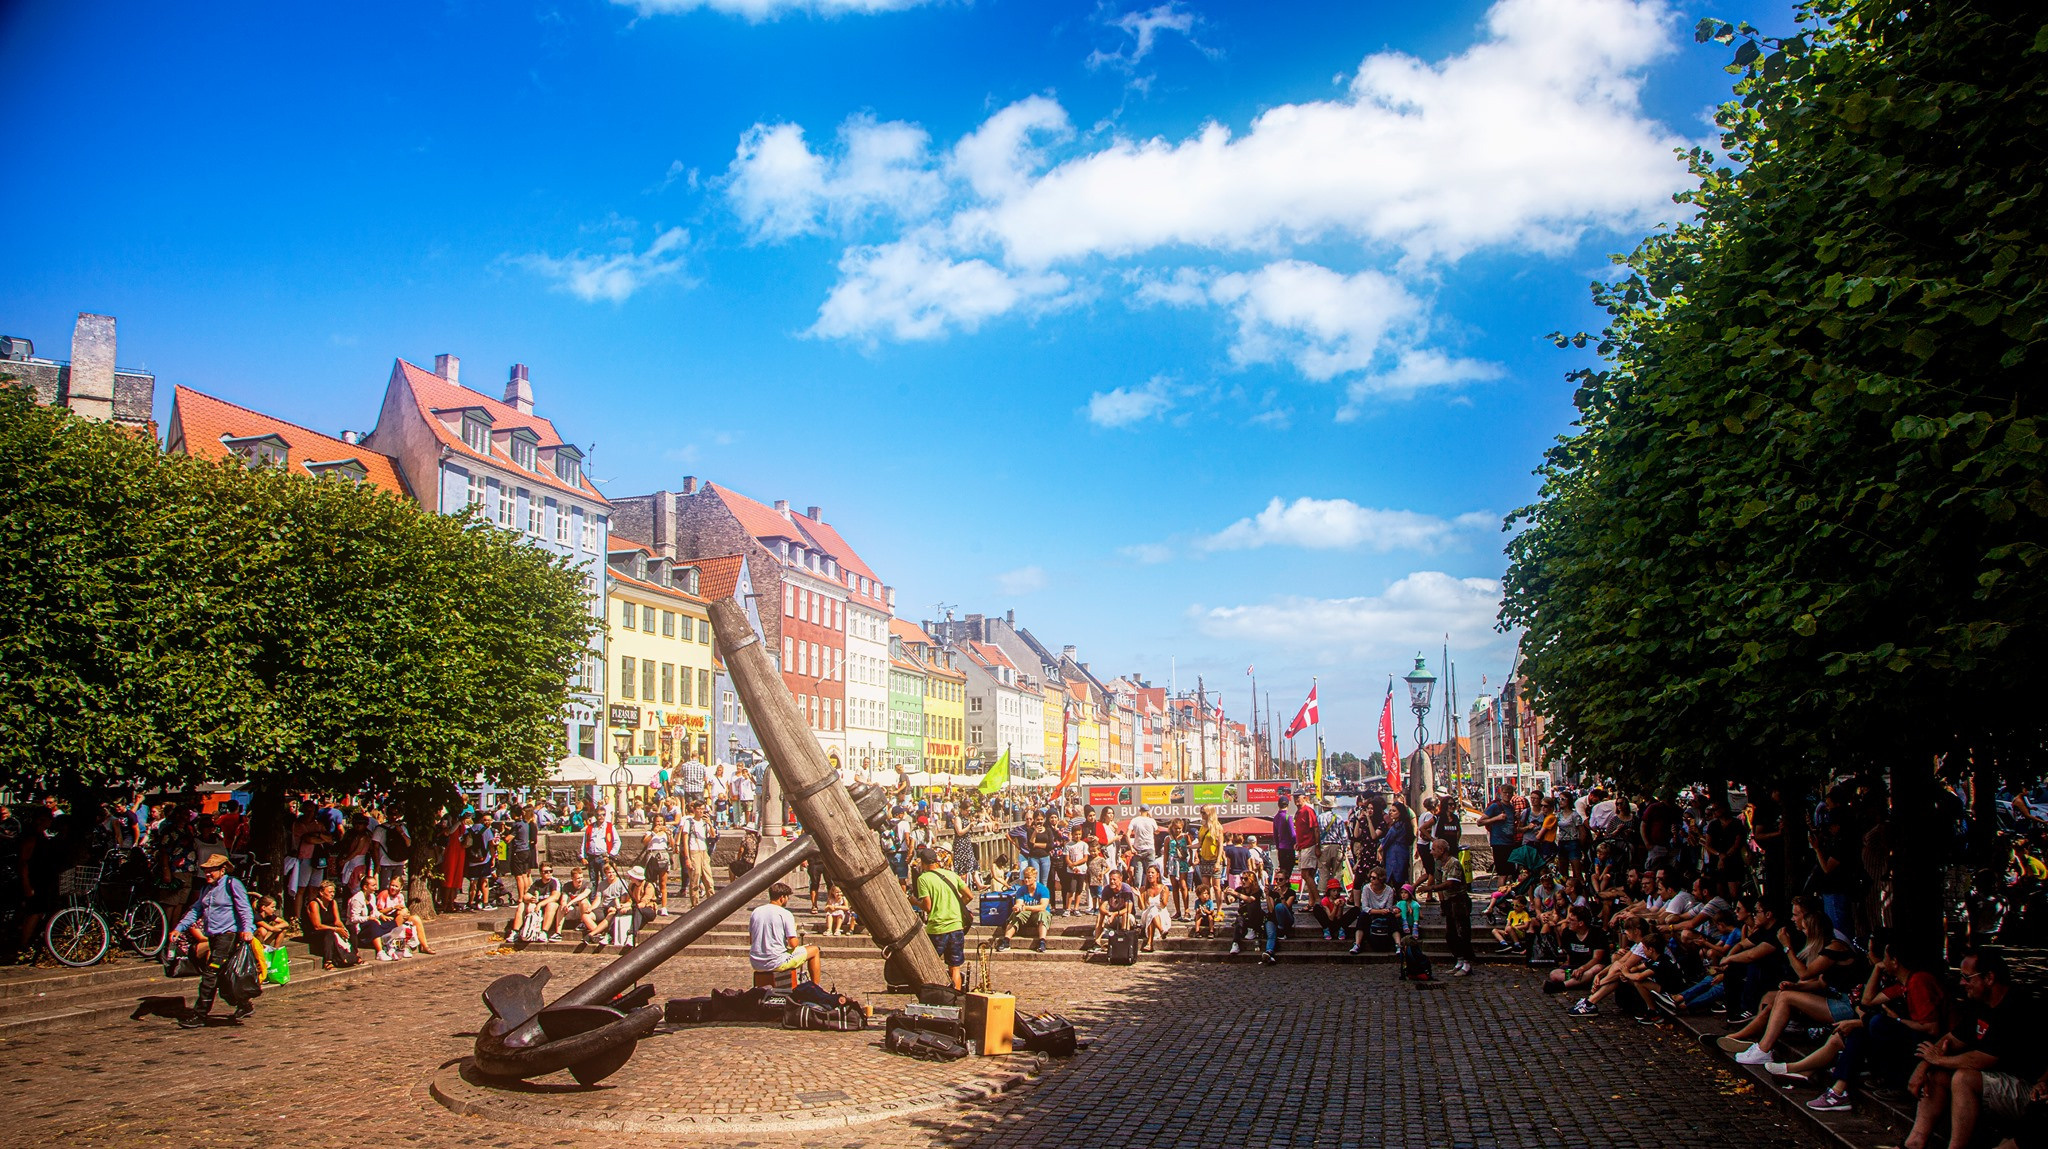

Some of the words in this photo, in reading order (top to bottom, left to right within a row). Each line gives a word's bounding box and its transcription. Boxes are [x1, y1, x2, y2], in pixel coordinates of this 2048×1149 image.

[611, 708, 638, 720] PLEASURE
[629, 757, 656, 765] TOILET
[1182, 804, 1228, 815] TICTS
[1230, 804, 1260, 814] HERE
[543, 1109, 618, 1119] DEN
[646, 1111, 827, 1123] DANSKE
